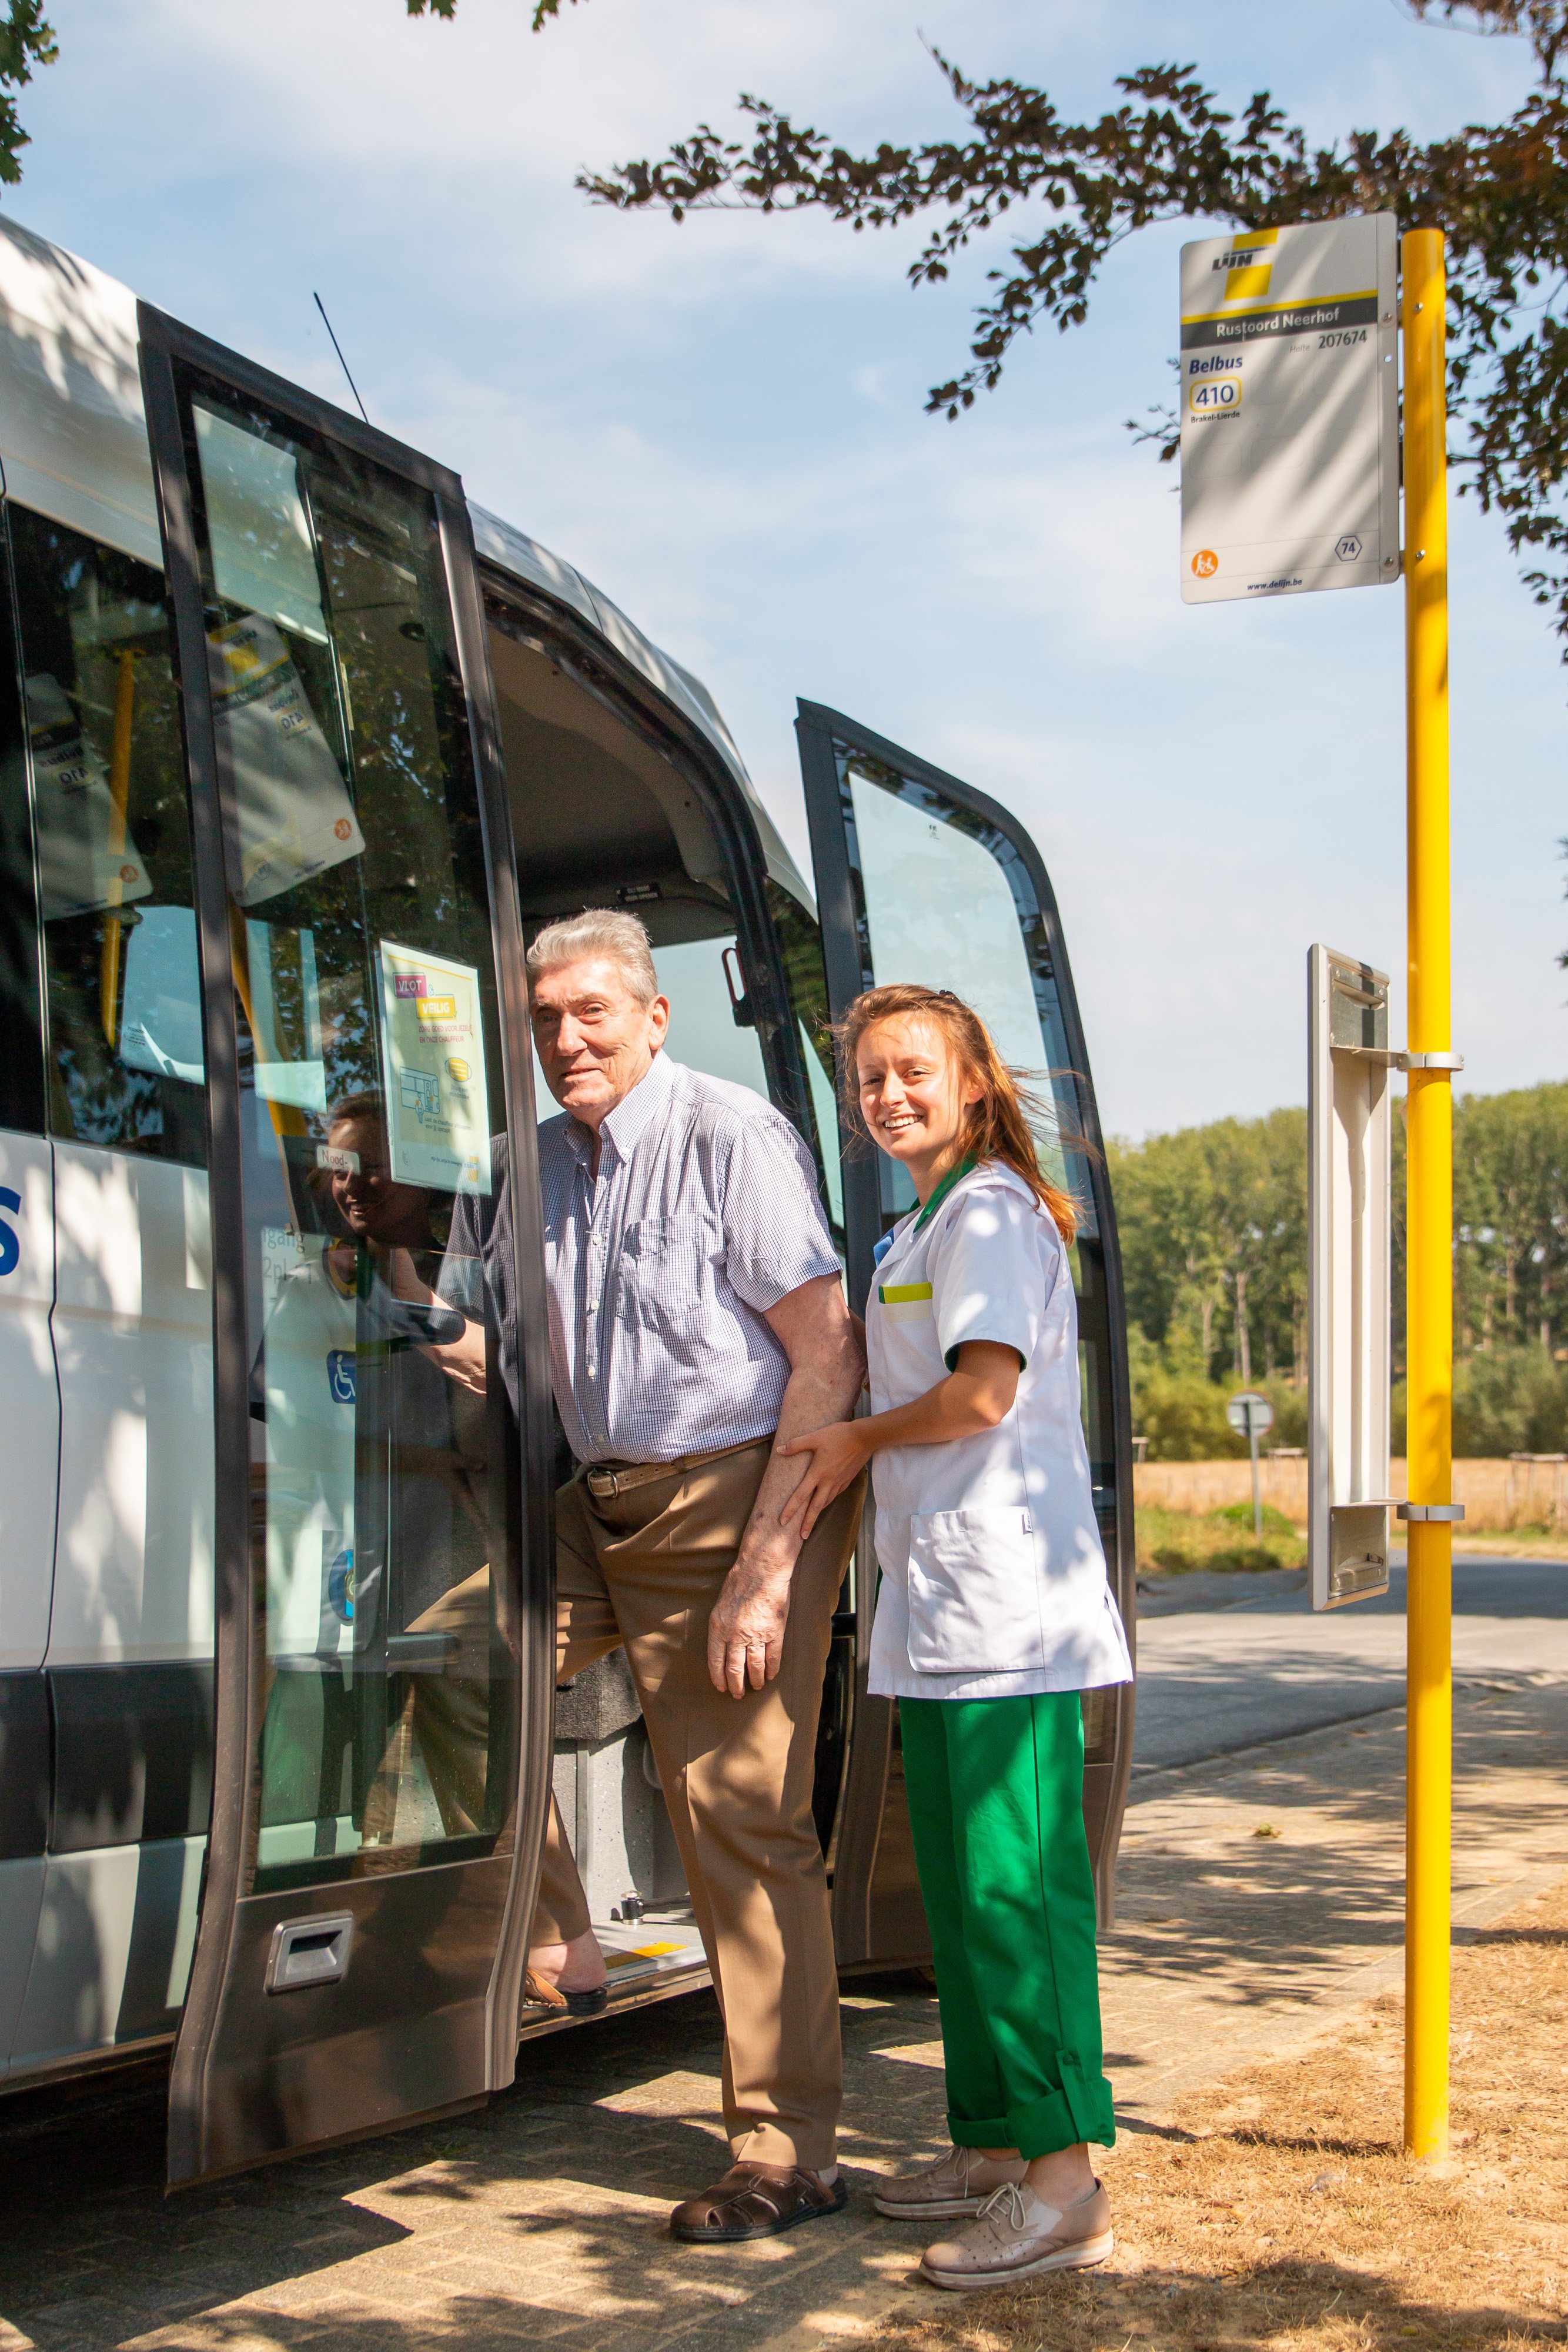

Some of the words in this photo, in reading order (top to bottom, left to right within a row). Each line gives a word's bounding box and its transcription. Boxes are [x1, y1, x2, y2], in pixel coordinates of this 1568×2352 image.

[1216, 316, 1279, 338] Rustoord
[1282, 307, 1340, 328] Neerhof
[1289, 344, 1311, 354] Halte
[1318, 330, 1368, 349] 207674
[1189, 355, 1243, 375] Belbus
[1195, 385, 1233, 406] 410
[1191, 411, 1241, 423] Brakel-Lierde
[1342, 542, 1356, 554] 74
[1247, 578, 1302, 591] www.delijn.be
[398, 980, 422, 993] VLOT
[422, 1001, 450, 1014] VEILIG
[322, 1149, 348, 1166] Nood-
